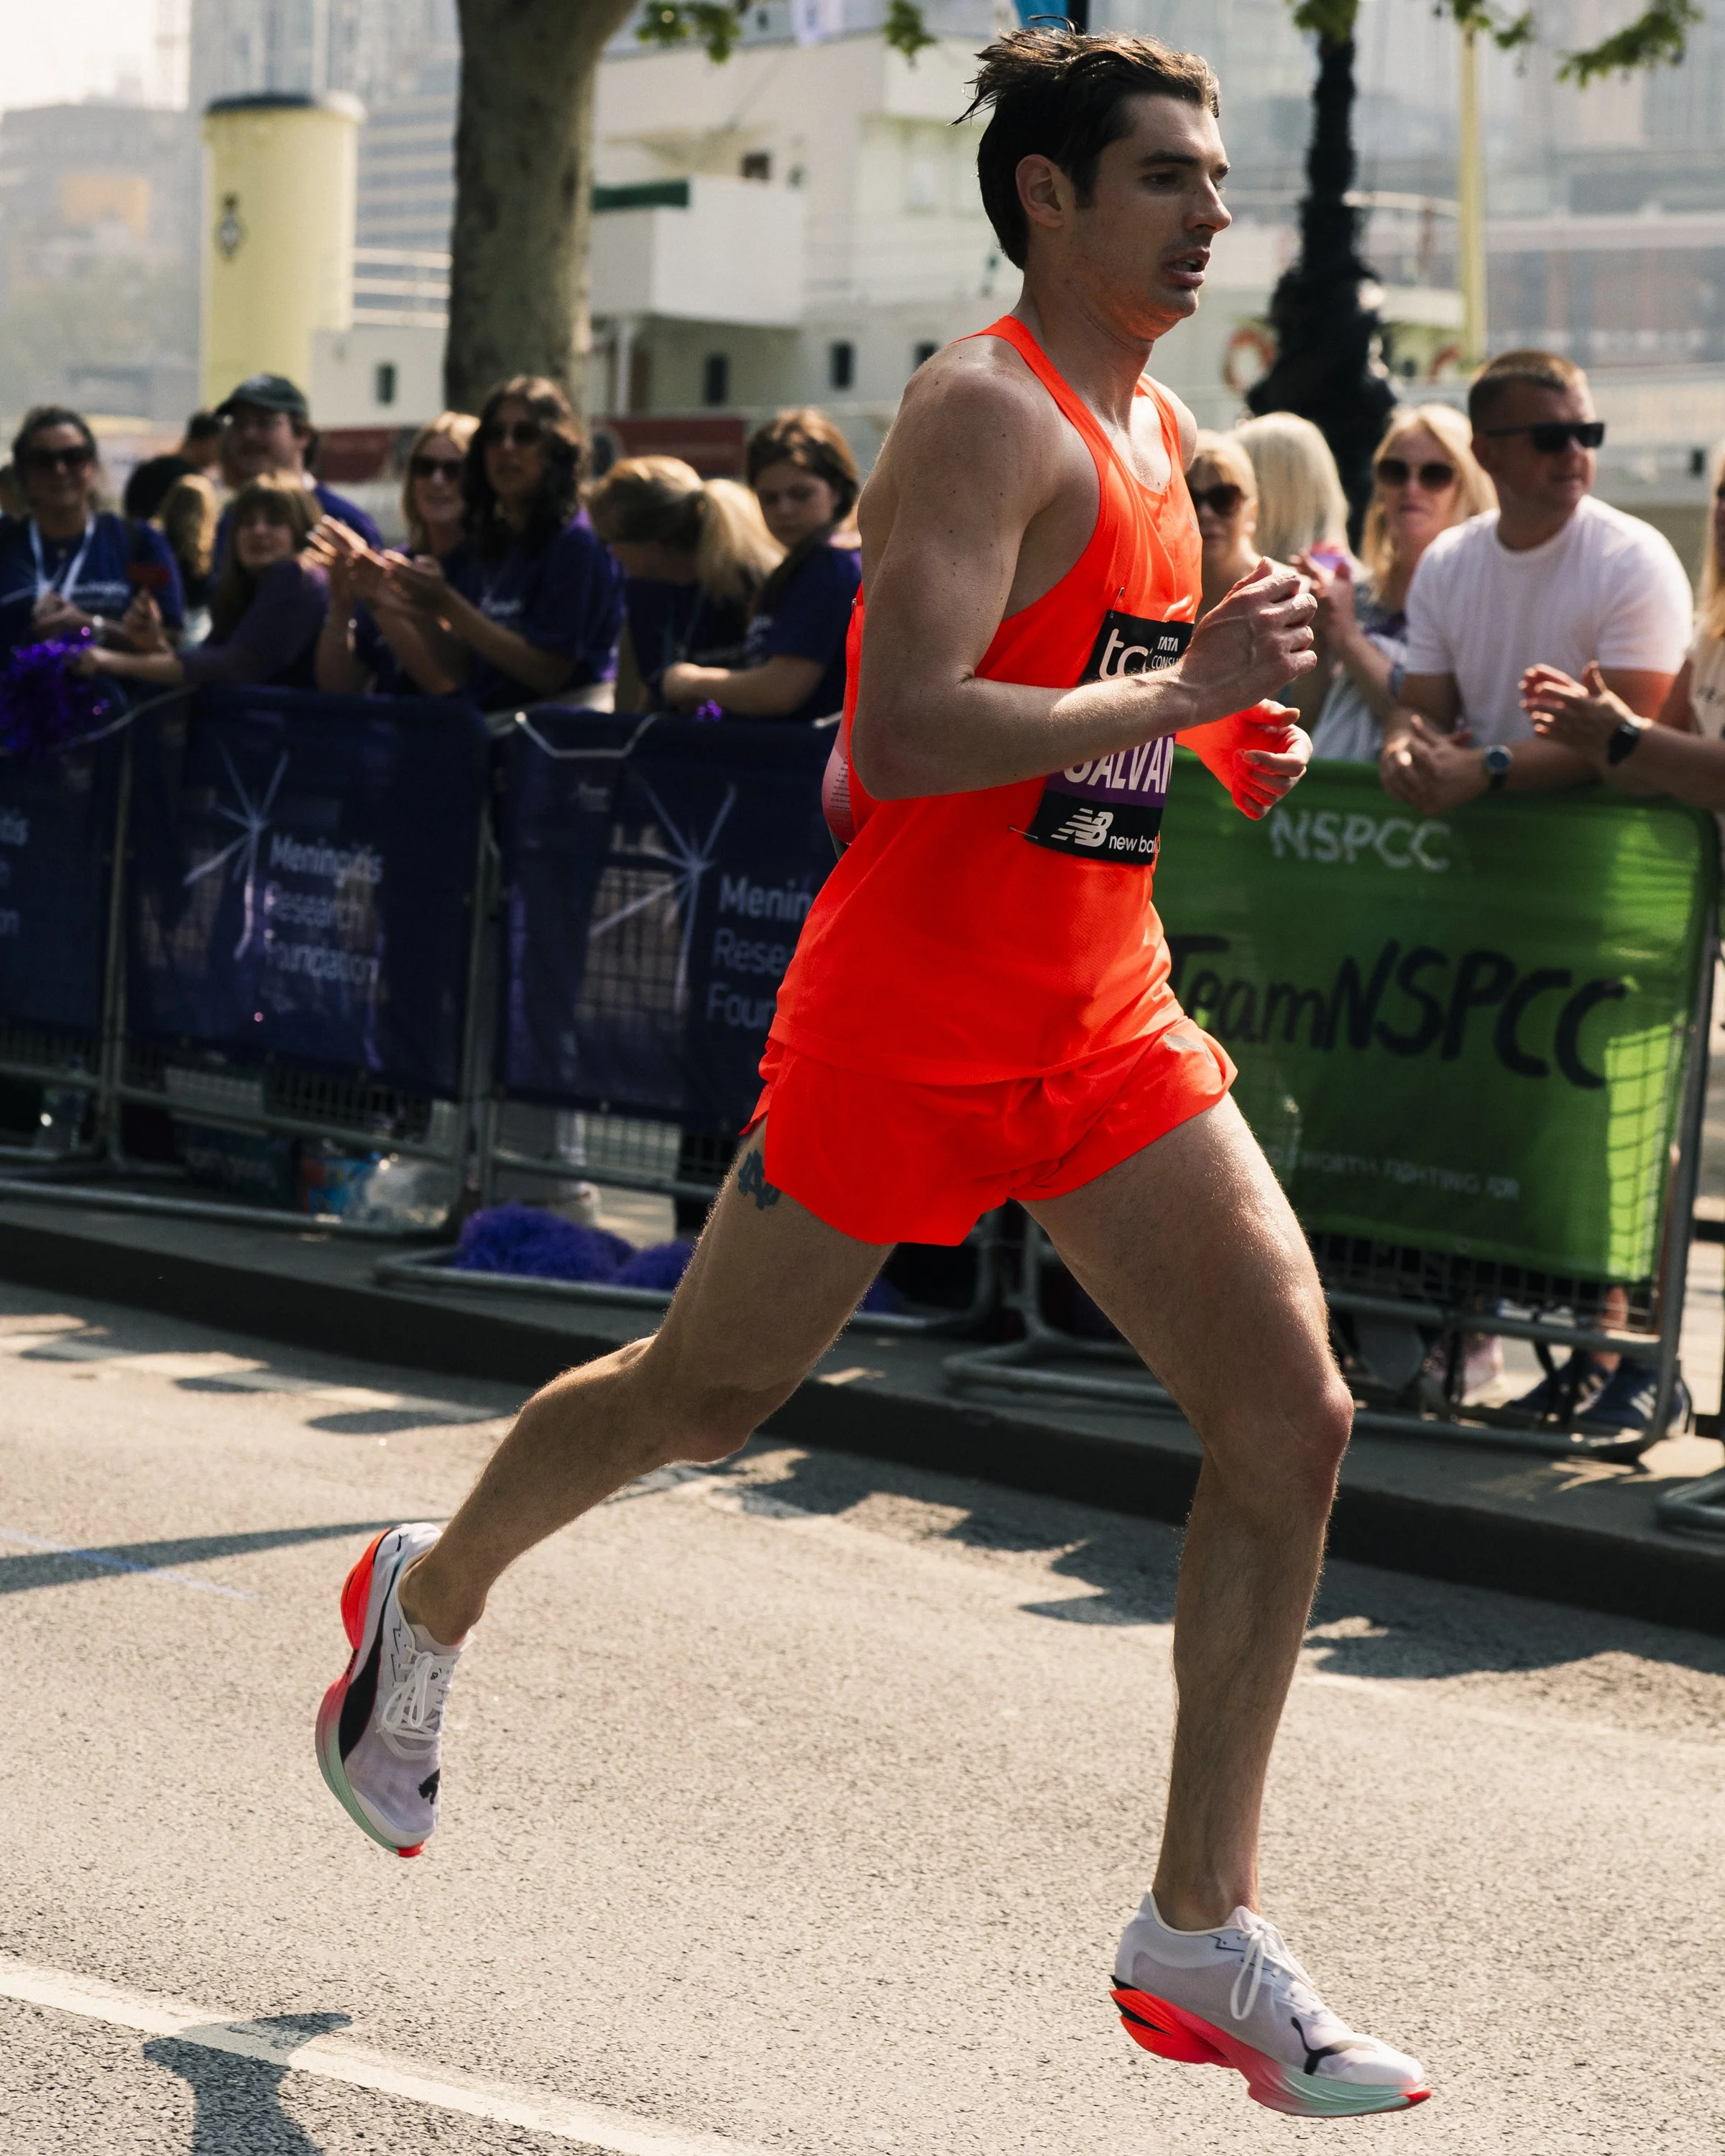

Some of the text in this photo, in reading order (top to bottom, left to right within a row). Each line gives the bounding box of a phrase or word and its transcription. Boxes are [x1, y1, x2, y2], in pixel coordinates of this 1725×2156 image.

[1099, 628, 1152, 680] tc
[1157, 636, 1179, 652] TATA
[1109, 835, 1138, 851] new
[1270, 808, 1450, 872] NSPCC
[1169, 935, 1627, 1090] TeamNSPCC
